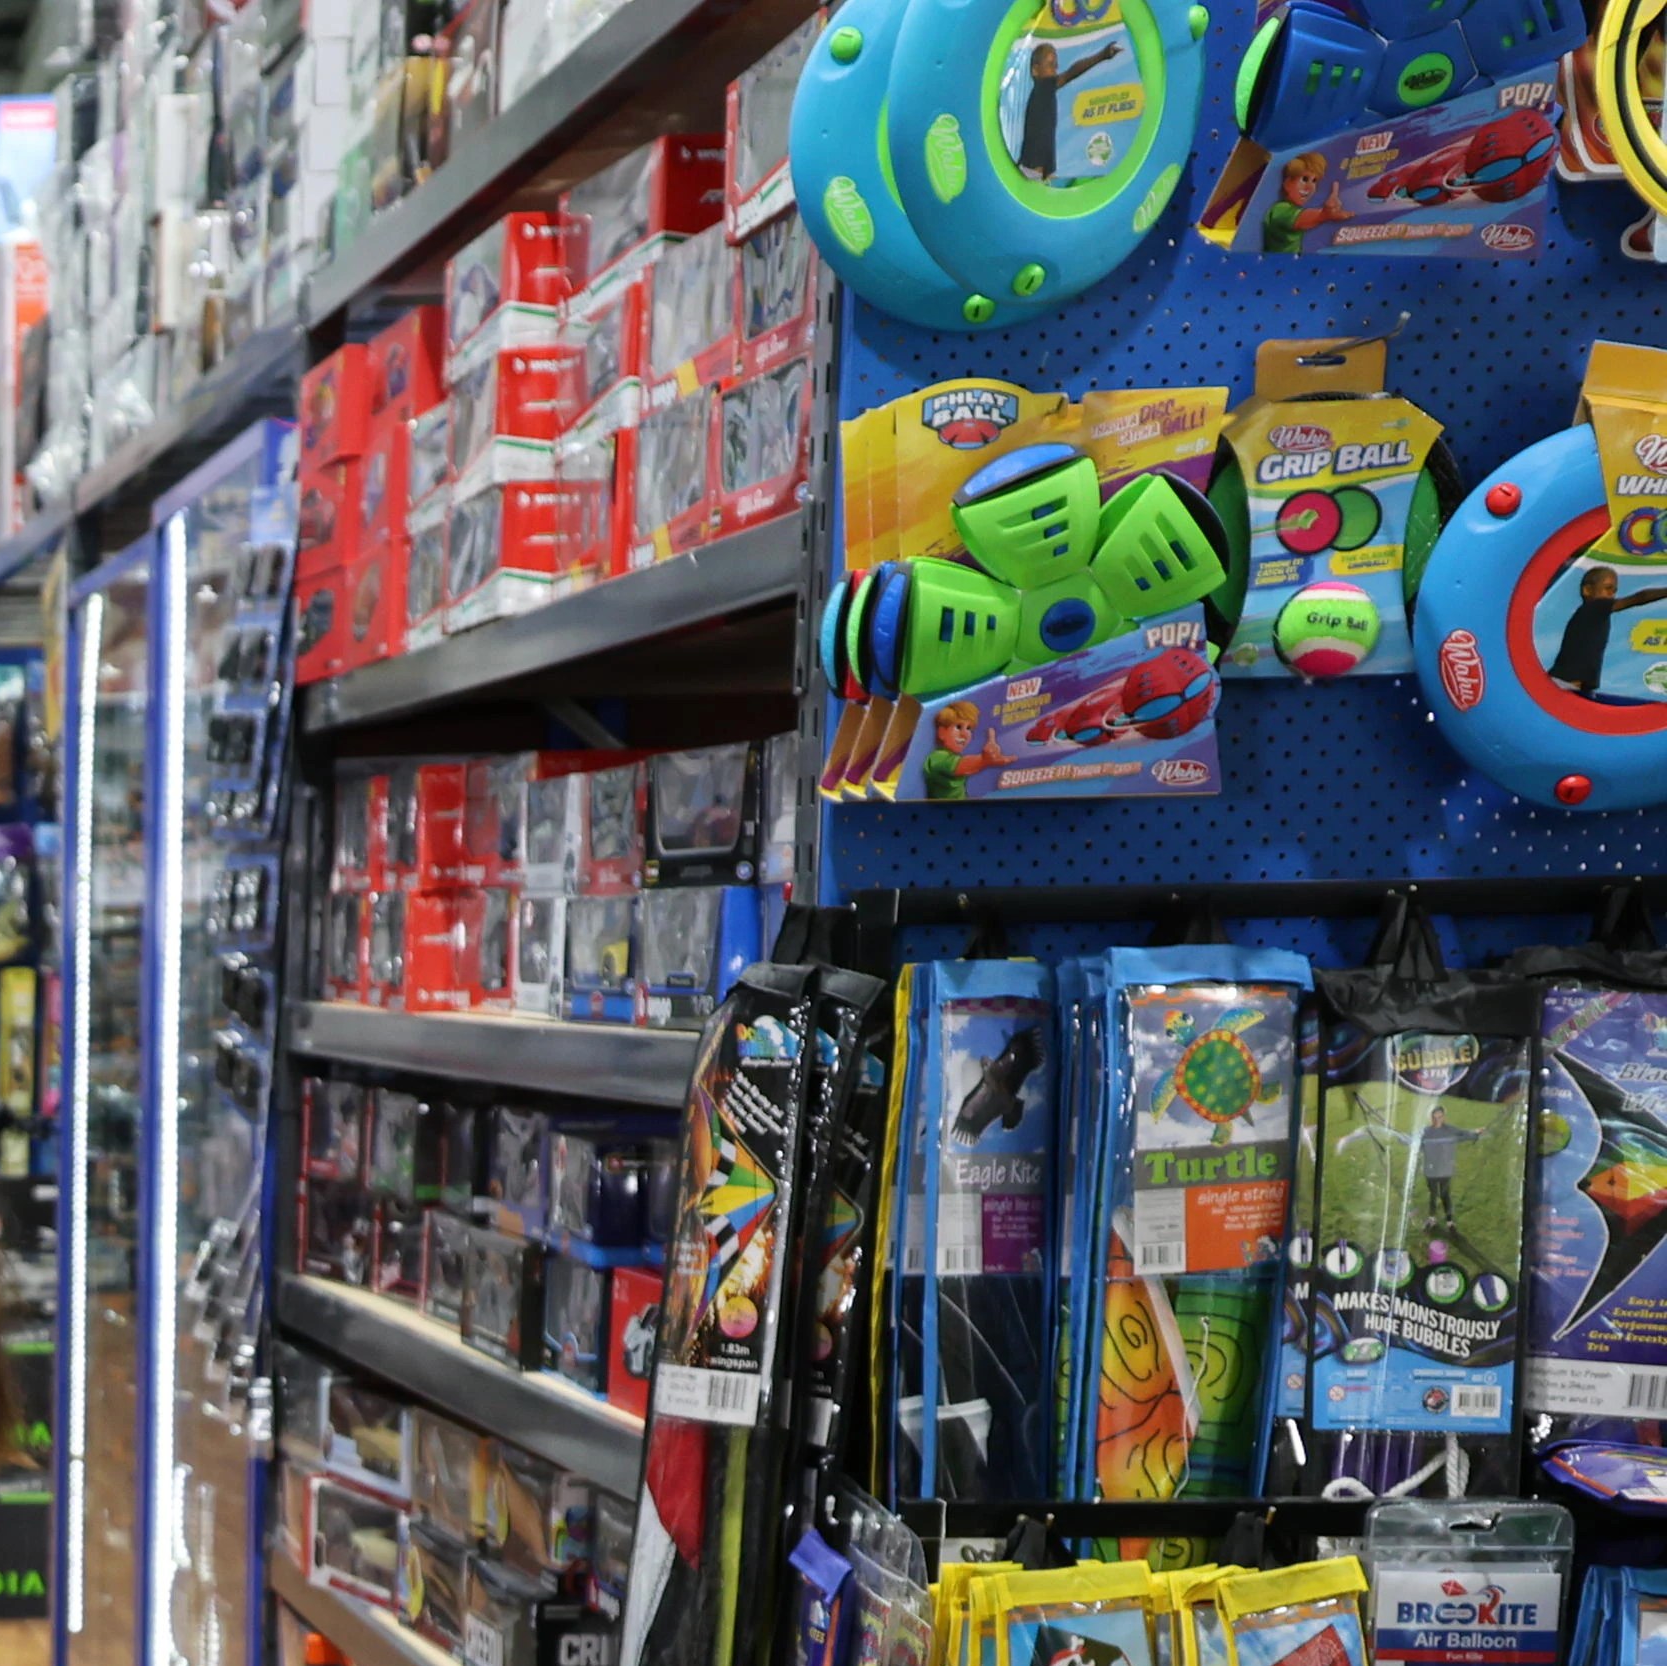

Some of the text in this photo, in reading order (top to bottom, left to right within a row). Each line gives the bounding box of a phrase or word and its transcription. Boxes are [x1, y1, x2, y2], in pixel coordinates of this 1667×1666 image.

[1500, 83, 1552, 110] POP!
[1482, 225, 1535, 250] Wahu
[933, 391, 1009, 409] PHLAT
[932, 405, 1010, 428] BALL
[1269, 424, 1331, 449] Wahu
[1259, 441, 1412, 482] GRIP BALL
[1307, 611, 1342, 628] Grip
[1145, 622, 1202, 648] POP!
[1449, 631, 1481, 703] Wahu
[1009, 678, 1040, 698] NEW
[1002, 765, 1054, 785] SQUEEZE
[1152, 759, 1209, 784] Wahu
[1393, 1046, 1472, 1071] BUBBLE
[955, 1157, 1041, 1186] Eagle Kite
[1144, 1147, 1279, 1185] Turtle
[1196, 1188, 1241, 1205] single
[1334, 1291, 1501, 1342] MAKES MONSTROUSLY
[1364, 1313, 1472, 1359] HUGE BUBBLES
[1397, 1592, 1538, 1625] BROOKITE
[1414, 1632, 1517, 1649] Air Balloon
